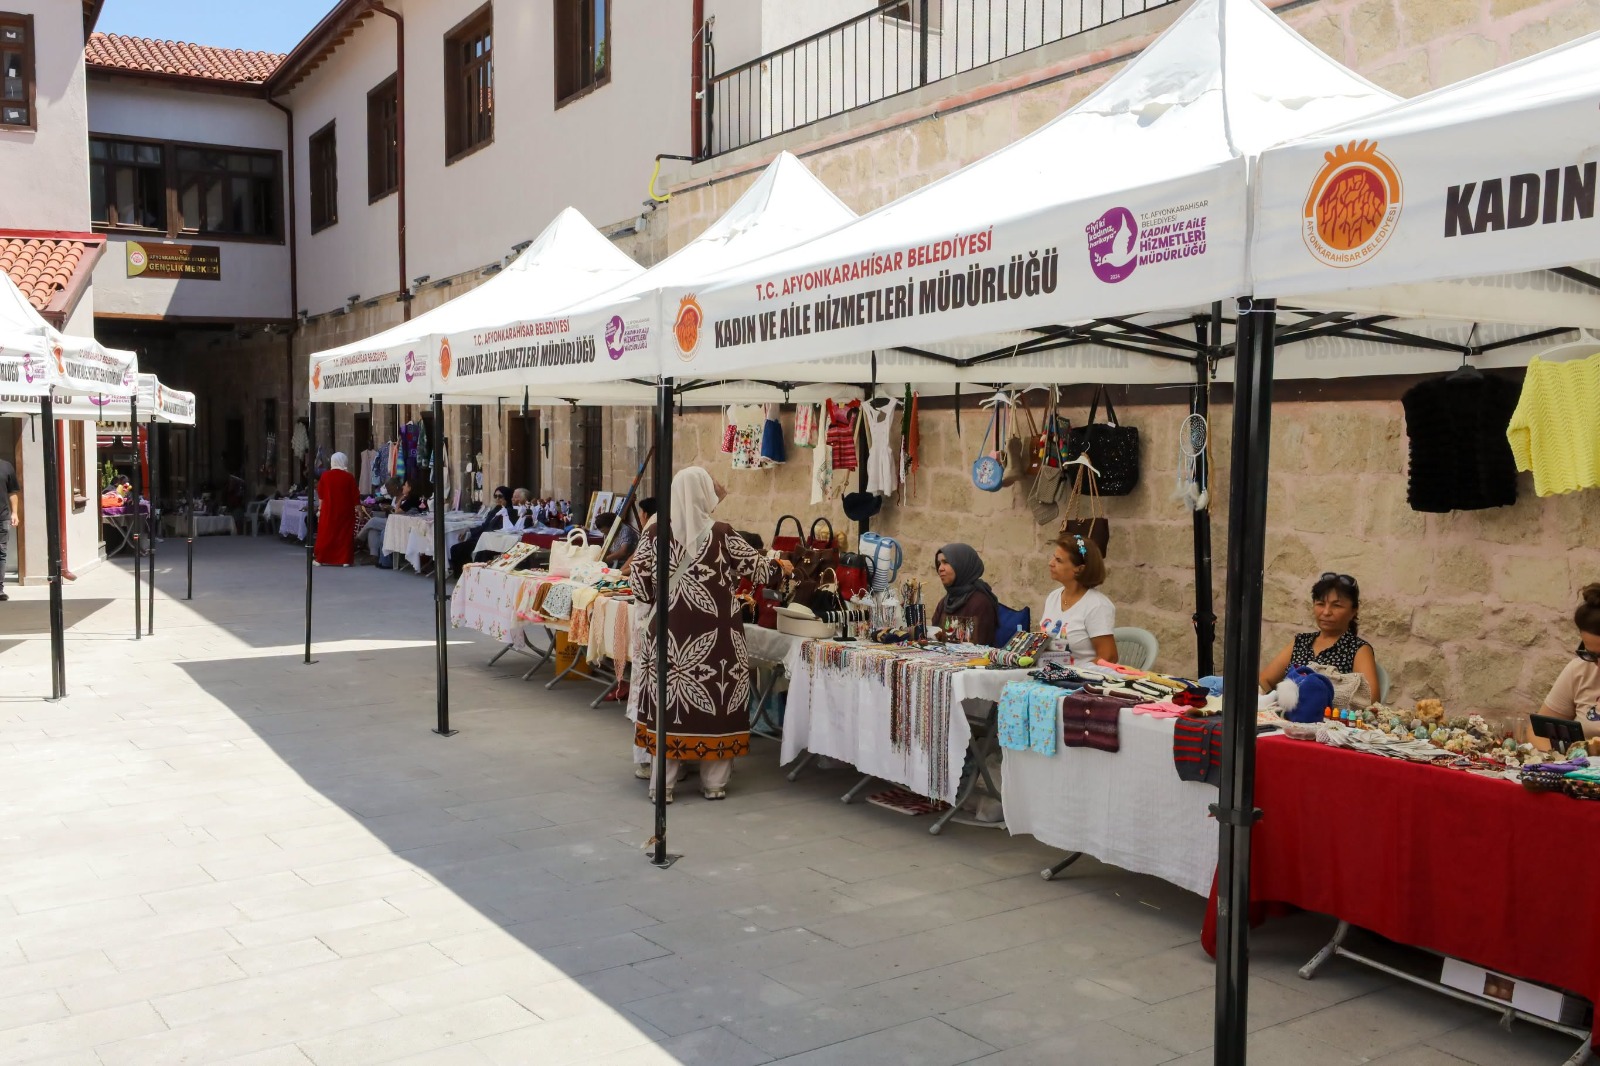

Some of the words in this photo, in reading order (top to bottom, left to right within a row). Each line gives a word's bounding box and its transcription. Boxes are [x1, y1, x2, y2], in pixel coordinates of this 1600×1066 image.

[1150, 200, 1208, 218] AFYONKARAHİSAR
[1444, 161, 1597, 238] KADIN
[1140, 225, 1171, 239] KADIN
[1173, 221, 1185, 232] VE
[1185, 216, 1207, 230] AİLE
[1141, 214, 1178, 228] BELEDİYESİ
[1307, 220, 1361, 263] AFYONKARAHİSAR
[1361, 206, 1398, 256] BELEDİYESİ
[1140, 227, 1206, 252] HİZMETLERİ
[756, 282, 778, 301] T.C.
[782, 251, 903, 296] AFYONKARAHİSAR
[907, 225, 994, 268] BELEDİYESİ
[1139, 241, 1207, 266] MÜDÜRLÜĞÜ
[149, 262, 183, 273] GENÇLİK
[714, 314, 756, 349] KADIN
[759, 311, 777, 342] VE
[779, 302, 811, 338] AİLE
[814, 276, 914, 333] HİZMETLERİ
[919, 246, 1059, 315] MÜDÜRLÜĞÜ
[484, 323, 534, 345] AFYONKARAHİSAR
[535, 316, 570, 336] BELEDİYESİ
[456, 355, 475, 377] KADIN
[475, 354, 484, 374] VE
[483, 349, 497, 373] AİLE
[497, 341, 540, 371] HİZMETLERİ
[541, 334, 596, 366] MÜDÜRLÜĞÜ
